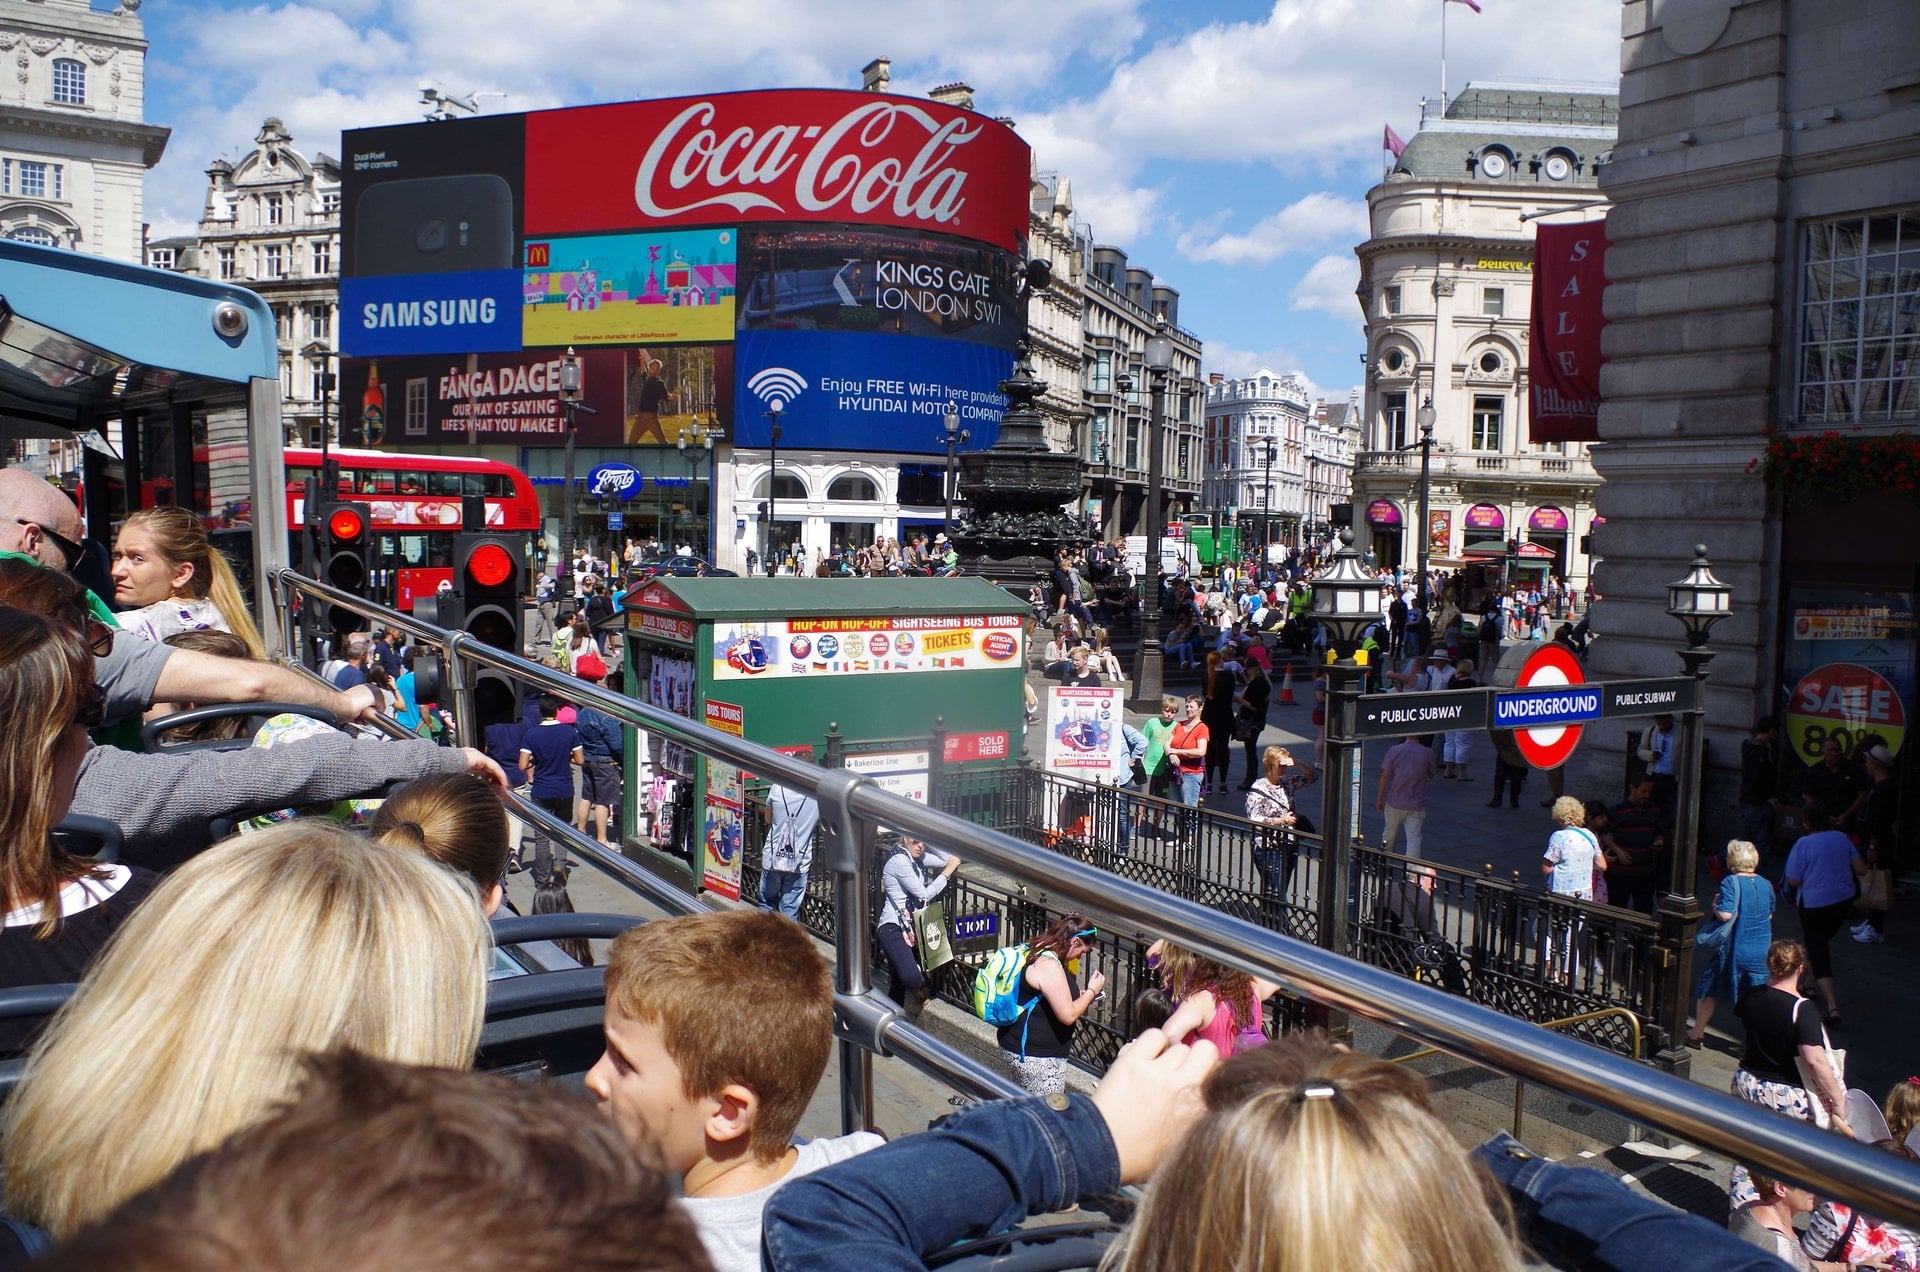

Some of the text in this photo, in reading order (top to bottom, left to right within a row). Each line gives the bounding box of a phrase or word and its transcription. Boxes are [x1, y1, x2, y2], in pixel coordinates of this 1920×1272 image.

[354, 153, 369, 161] Dual
[370, 160, 398, 169] camera
[635, 101, 984, 223] Coca-Cola
[1477, 257, 1524, 270] Believe
[876, 260, 990, 297] KINGS GATE
[363, 298, 496, 329] SAMSUNG
[876, 286, 1001, 326] LONDON SW1
[1556, 239, 1590, 377] SALE
[439, 366, 499, 400] FÅNGA
[821, 377, 862, 395] Enjoy
[866, 379, 904, 395] FREE
[909, 381, 941, 397] Wi-Fi
[944, 386, 969, 400] here
[971, 391, 1002, 406] provided
[452, 399, 558, 416] OUR WAY OF SAYING
[839, 396, 907, 413] HYUNDAI
[962, 405, 1004, 423] COMPANY
[441, 419, 467, 431] LIFE'S
[467, 418, 494, 432] WHAT
[495, 418, 517, 432] YOU
[520, 418, 558, 433] MAKE
[592, 468, 639, 494] Boots
[643, 613, 655, 627] BUS
[656, 615, 677, 632] TOURS
[793, 615, 1020, 631] HOP-ON HOP-OFF SIGHTSEEING BUS TOURS
[924, 631, 971, 650] TICKETS
[988, 634, 1014, 644] OFFICIAL
[990, 642, 1011, 650] AGENT
[1498, 695, 1597, 718] UNDERGROUND
[1615, 691, 1677, 706] PUBLIC SUBWAY
[1801, 682, 1891, 720] SALE
[706, 703, 741, 722] BUS TOURS
[1380, 705, 1462, 723] PUBLIC SUBWAY
[709, 719, 739, 733] TICKETS HERE
[978, 735, 1004, 746] SOLD
[979, 745, 1004, 756] HERE
[854, 759, 885, 767] Bakerloo
[888, 778, 900, 786] line
